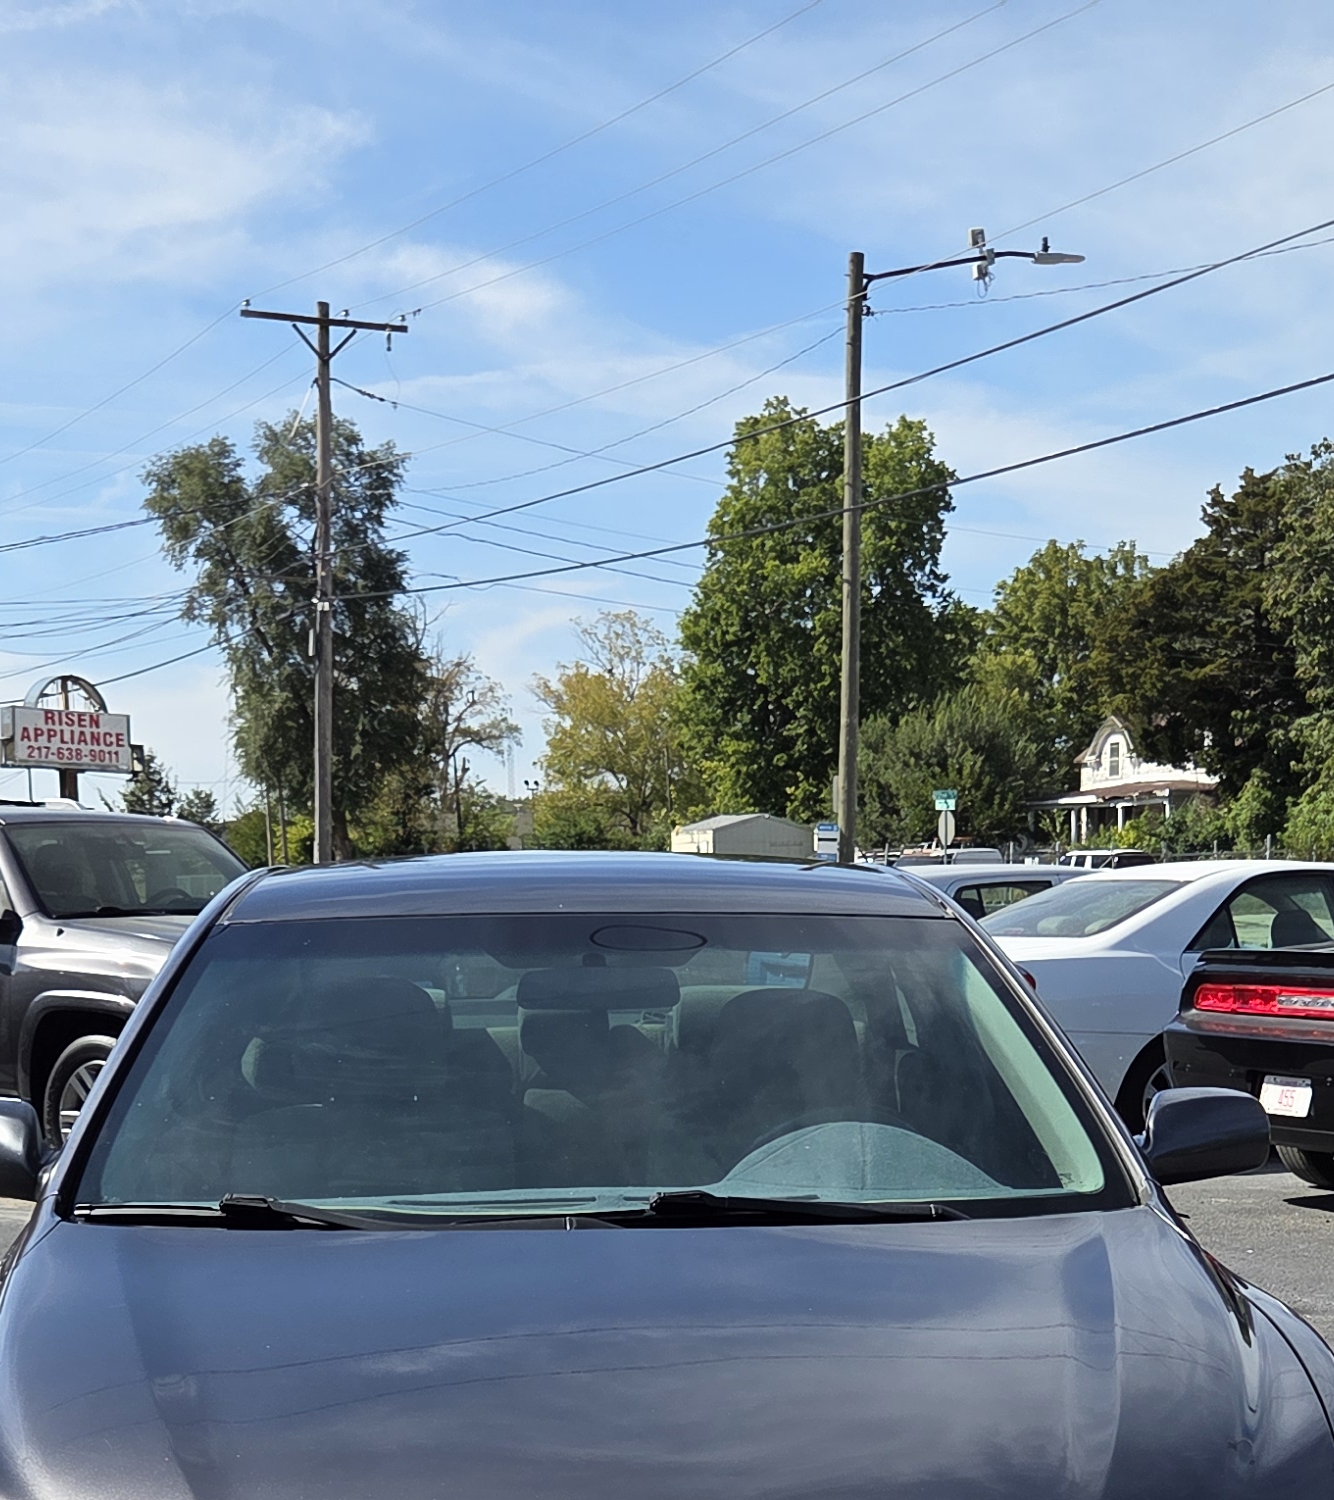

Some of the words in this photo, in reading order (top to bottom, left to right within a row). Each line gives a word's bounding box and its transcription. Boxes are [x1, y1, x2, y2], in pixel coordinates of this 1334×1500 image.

[44, 711, 100, 729] RISEN
[20, 727, 126, 748] APPLIANCE
[27, 745, 120, 763] 217-638-9011
